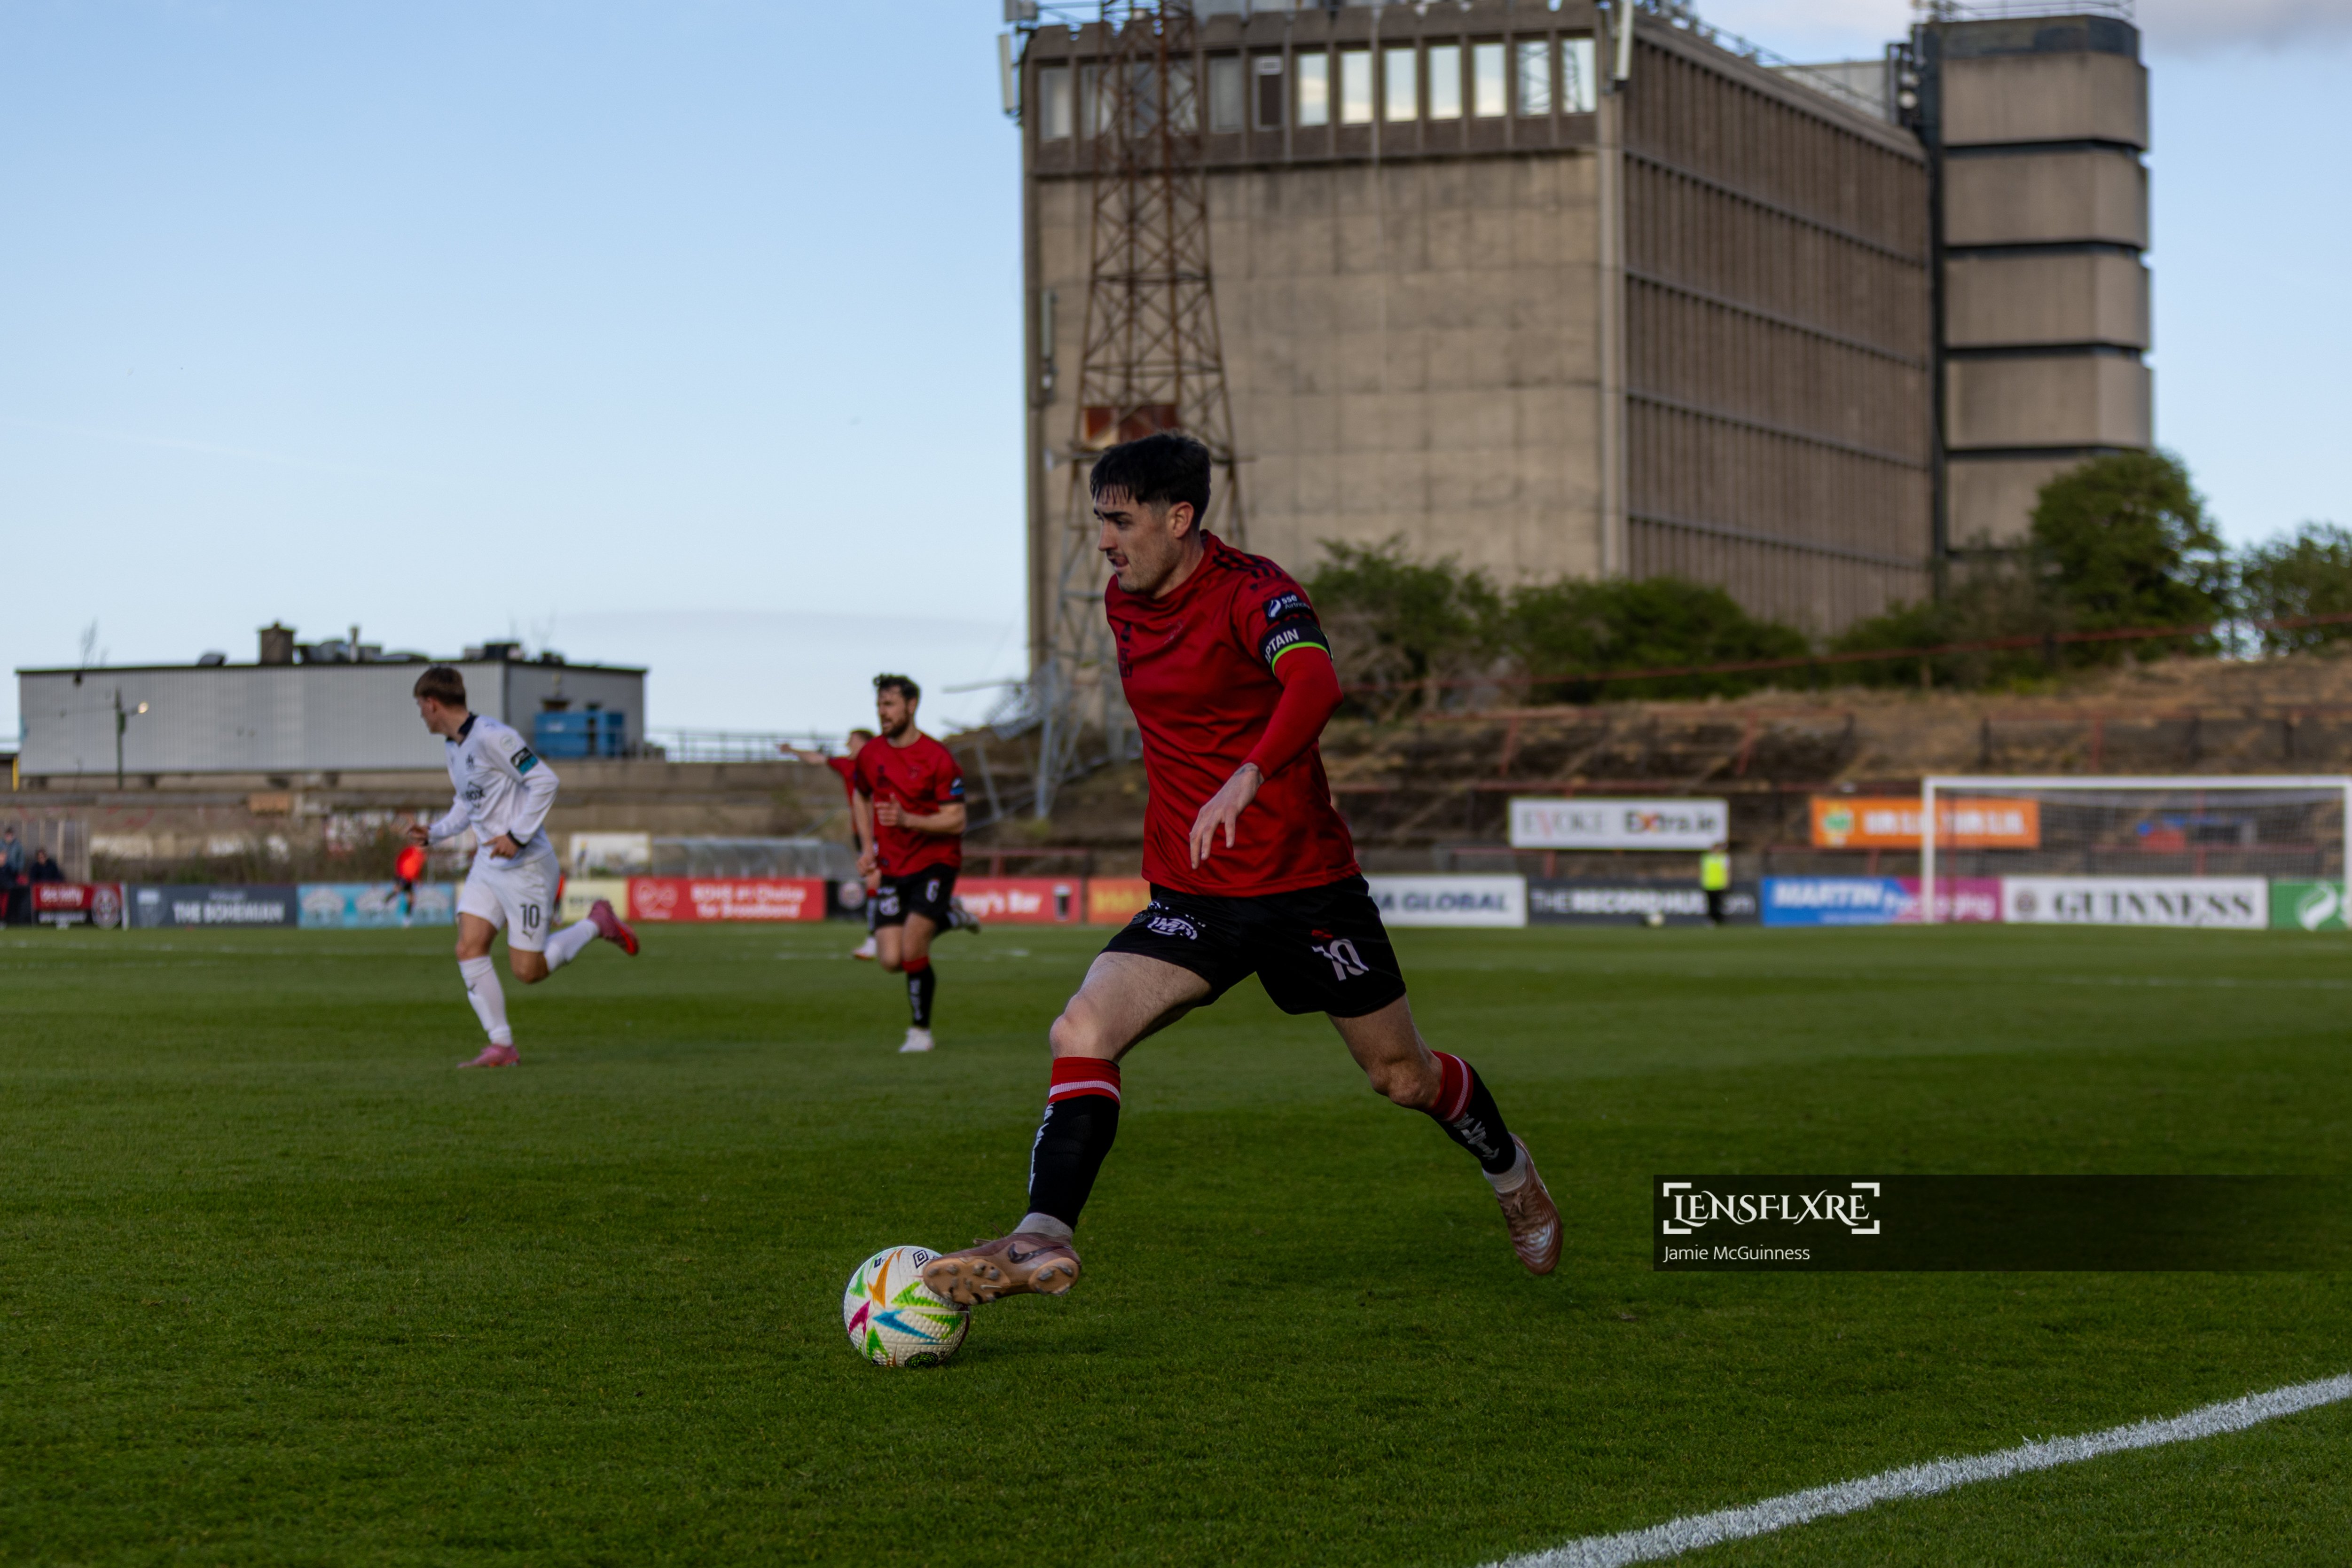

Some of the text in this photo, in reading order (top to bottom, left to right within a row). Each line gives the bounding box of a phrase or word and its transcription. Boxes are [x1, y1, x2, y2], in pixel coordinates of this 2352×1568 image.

[1624, 809, 1716, 834] Extra.ie
[1401, 891, 1509, 912] GLOBAL
[1773, 882, 1885, 908] MARTIN
[2054, 890, 2253, 919] GUINNESS
[173, 901, 284, 924] THE BOHEMIAN
[519, 903, 540, 929] 10
